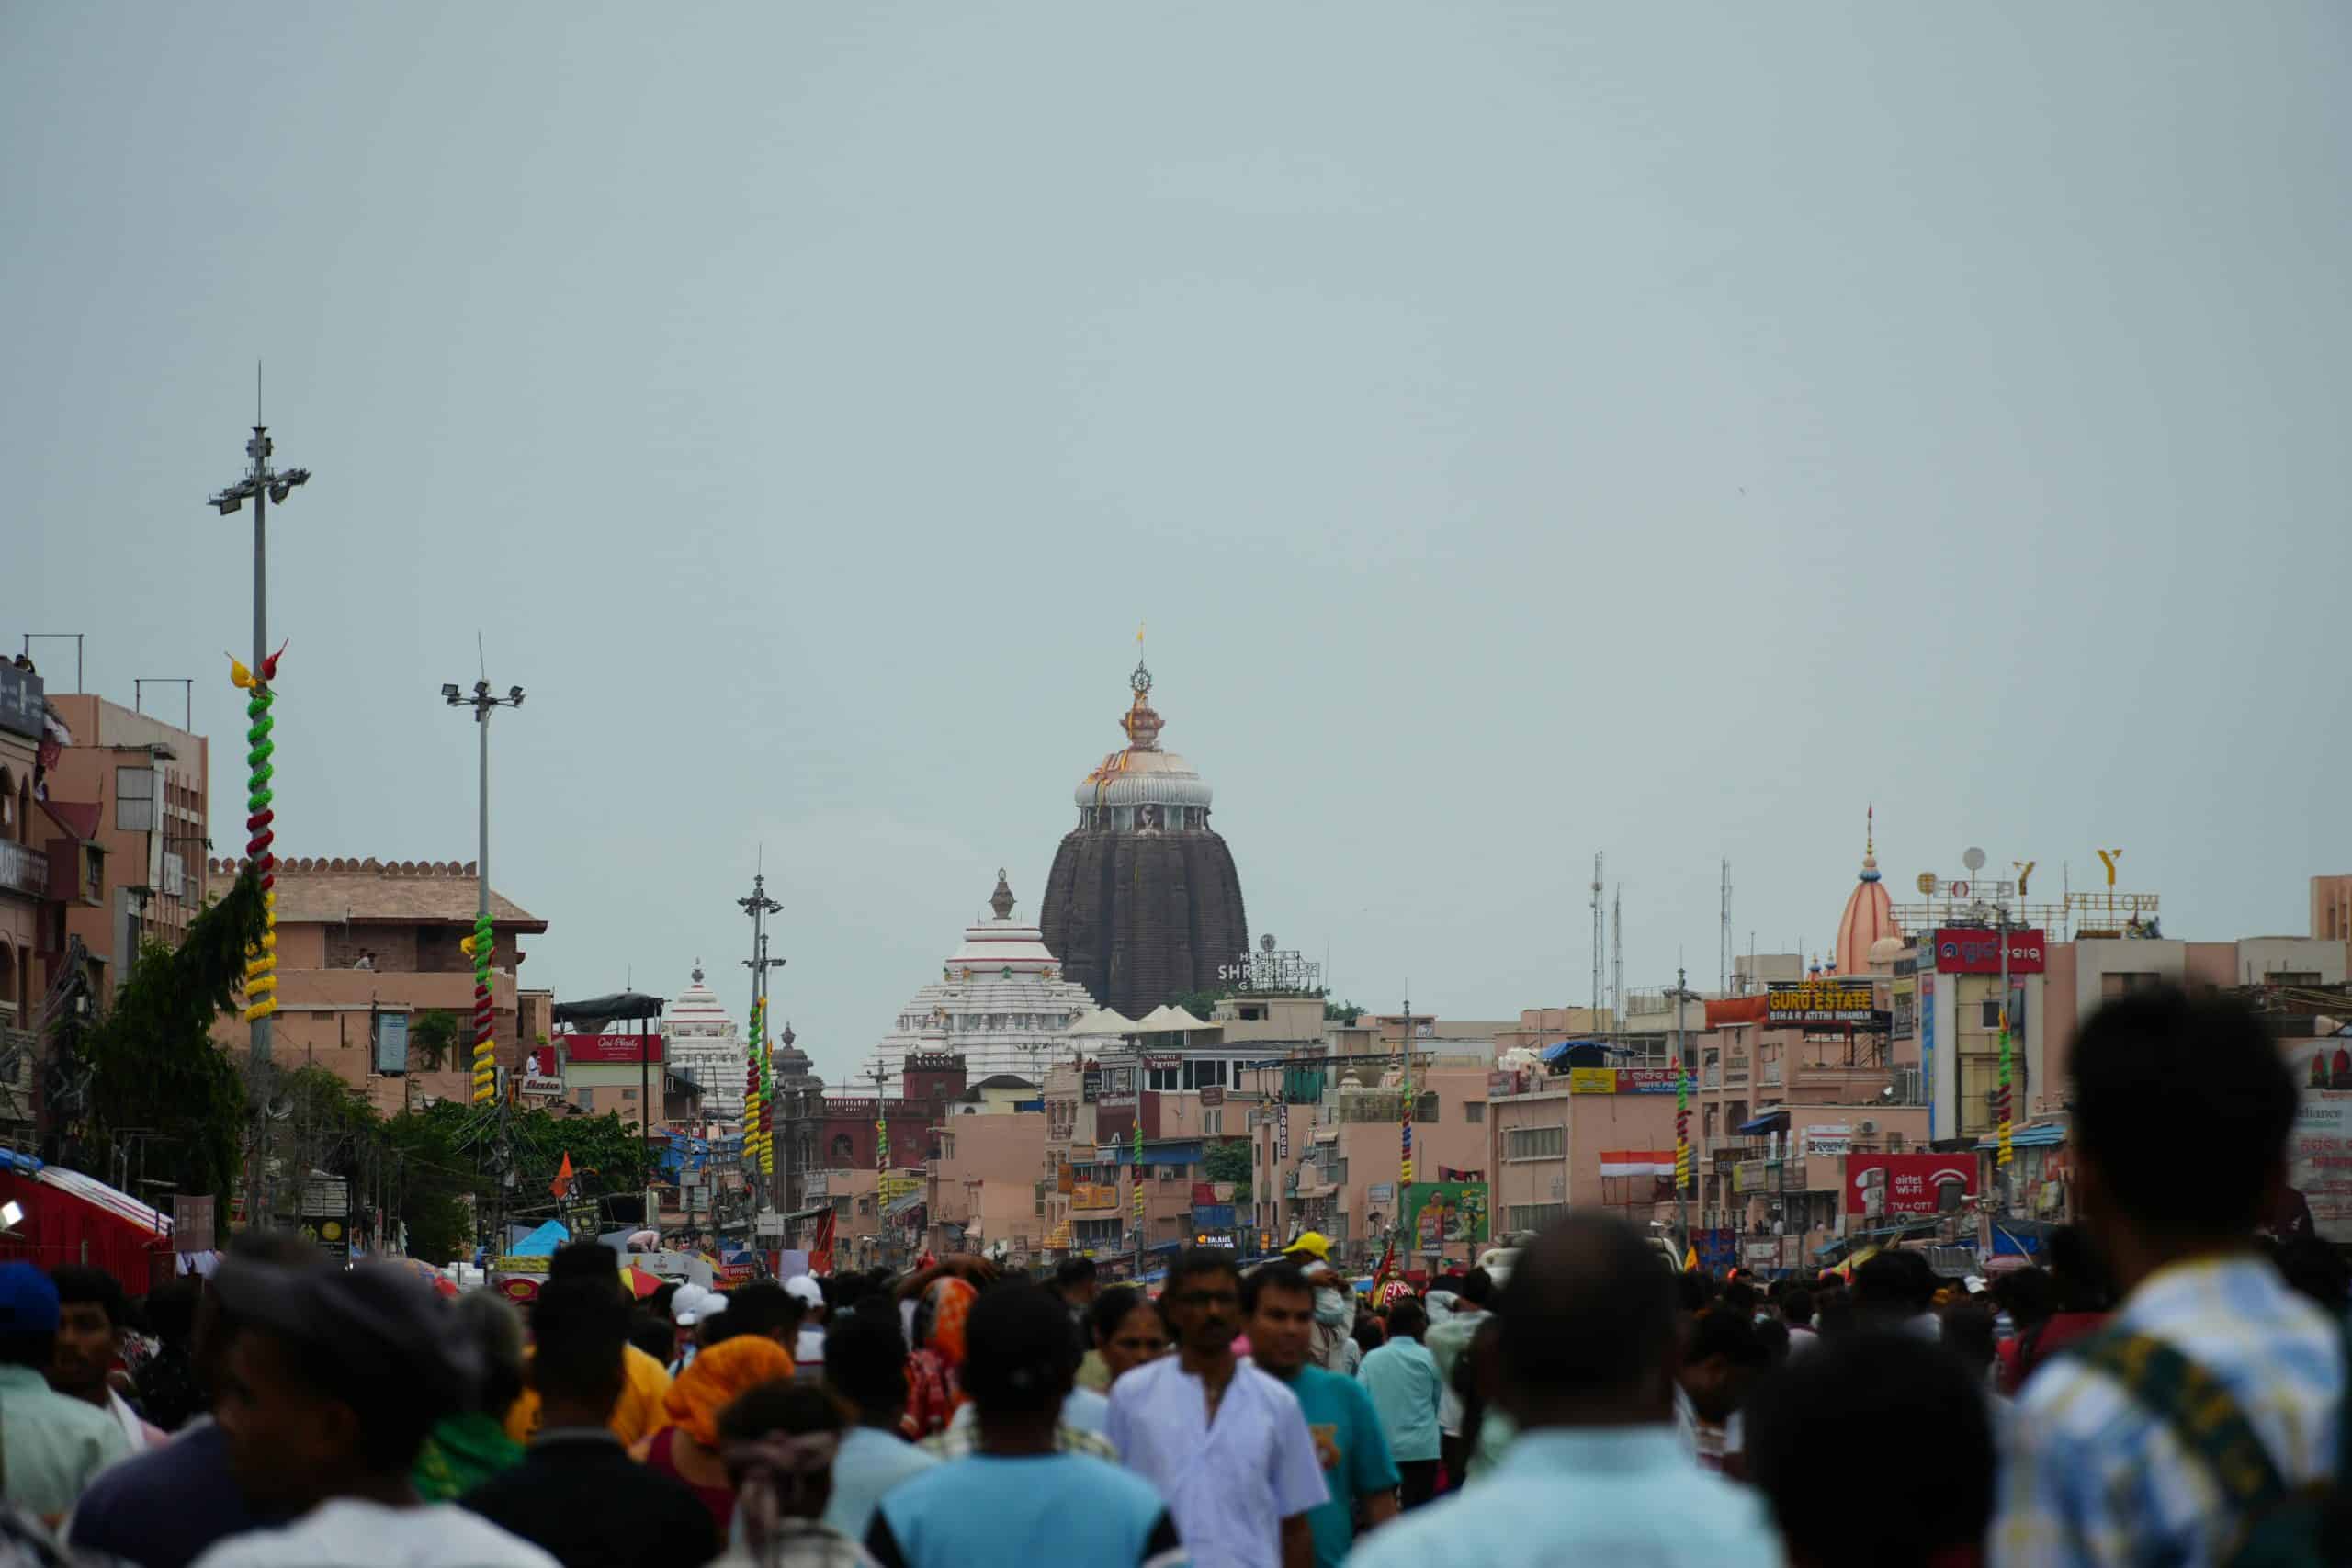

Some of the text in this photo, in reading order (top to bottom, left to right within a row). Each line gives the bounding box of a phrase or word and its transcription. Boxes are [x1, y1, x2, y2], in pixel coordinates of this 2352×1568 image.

[1770, 991, 1872, 1010] GURU ESTATE
[1770, 1011, 1801, 1021] BIHAR
[1895, 1174, 1922, 1184] airtel
[1895, 1185, 1922, 1194] Wi-Fi
[1891, 1201, 1903, 1211] TV
[1913, 1201, 1933, 1211] OTT
